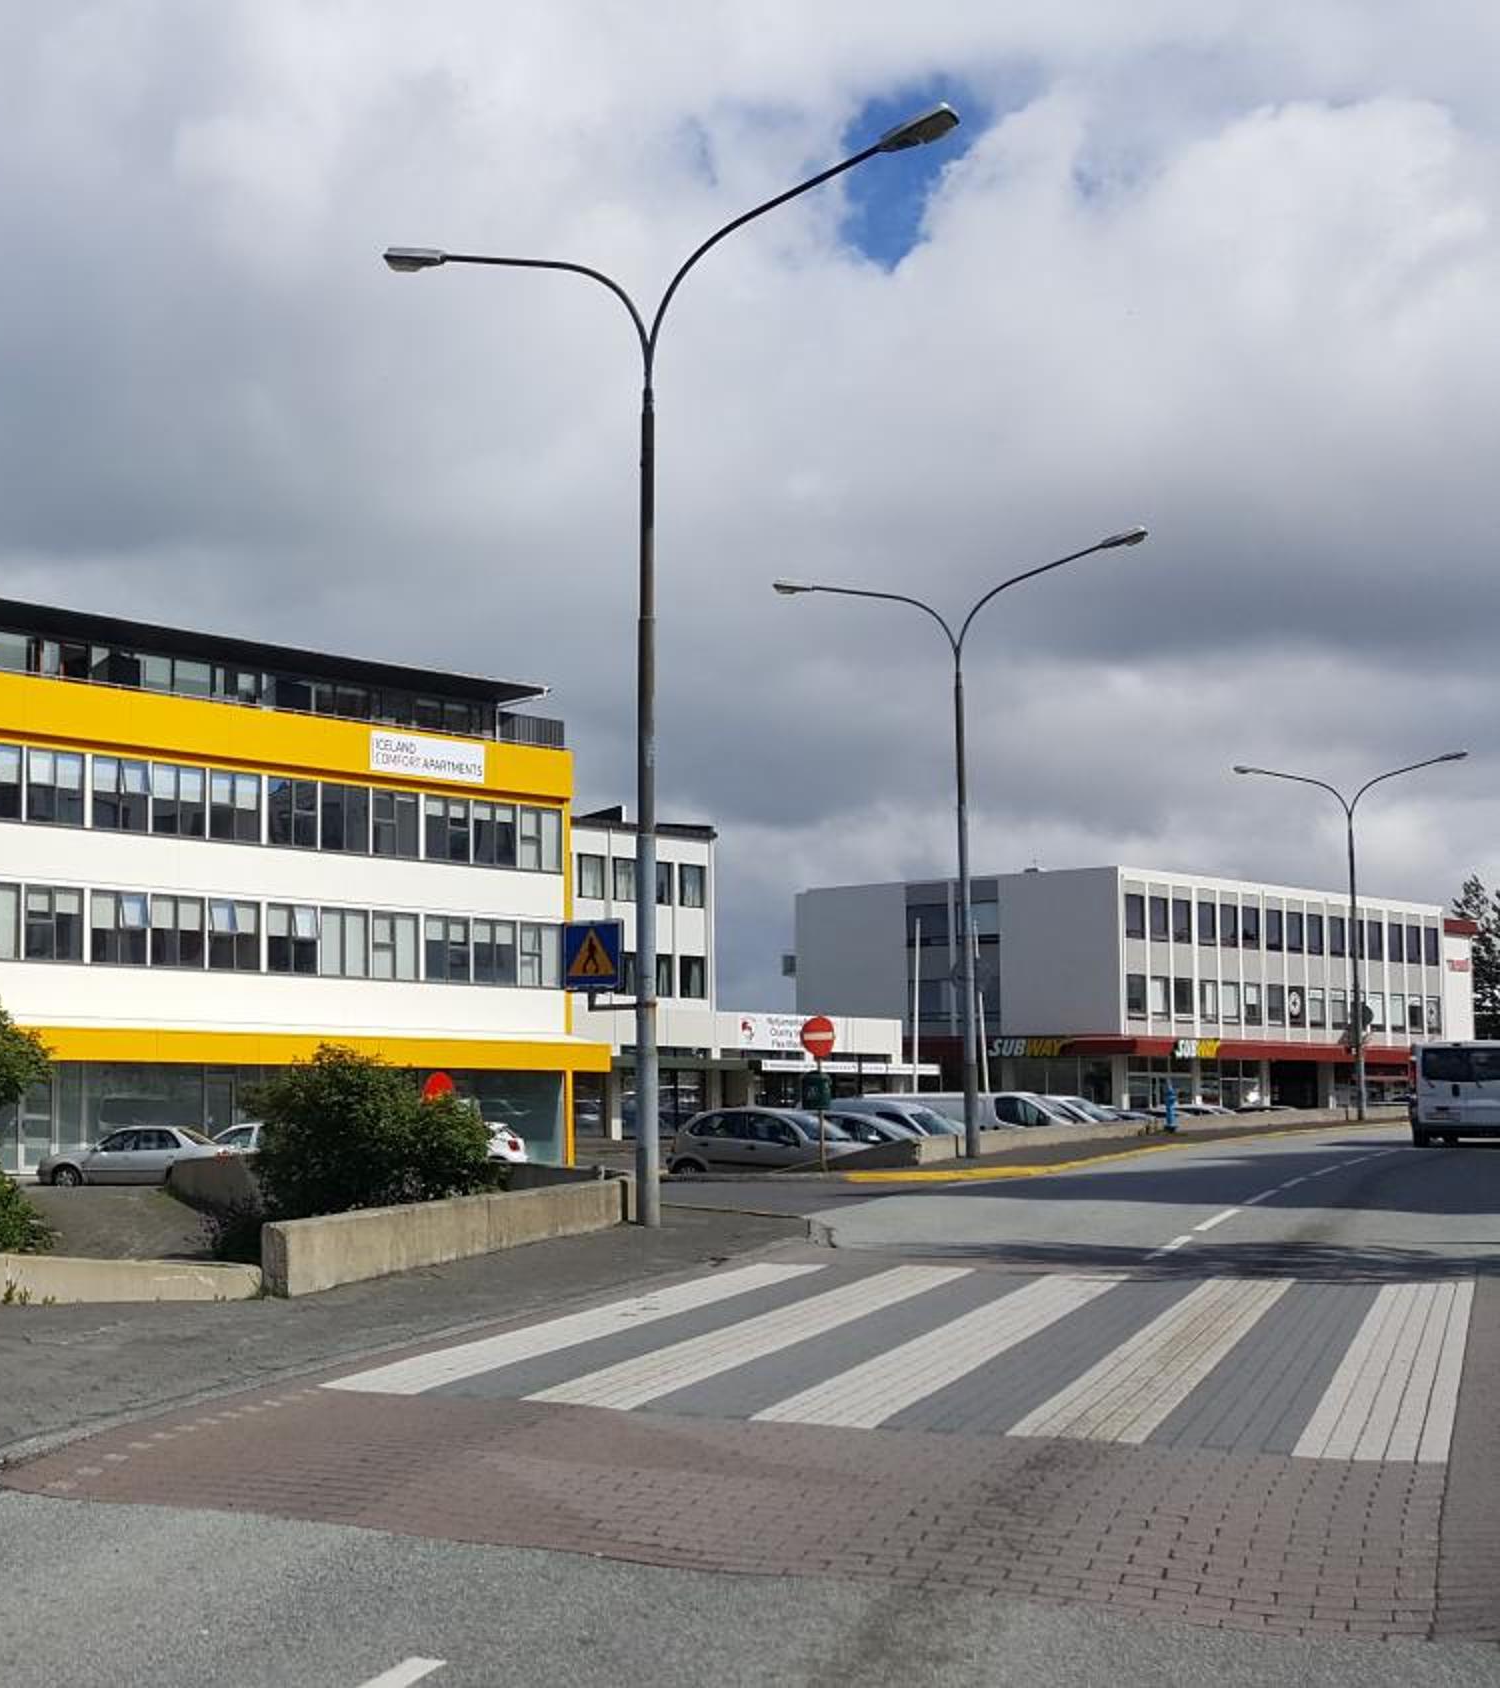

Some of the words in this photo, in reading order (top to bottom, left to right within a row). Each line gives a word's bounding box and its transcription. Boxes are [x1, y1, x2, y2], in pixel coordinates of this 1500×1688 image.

[376, 738, 417, 755] ICELAND
[375, 752, 420, 769] COMFORT
[422, 757, 483, 777] APARTMENTS
[988, 1038, 1064, 1057] SUBWAY
[1175, 1038, 1220, 1059] SUBWAY
